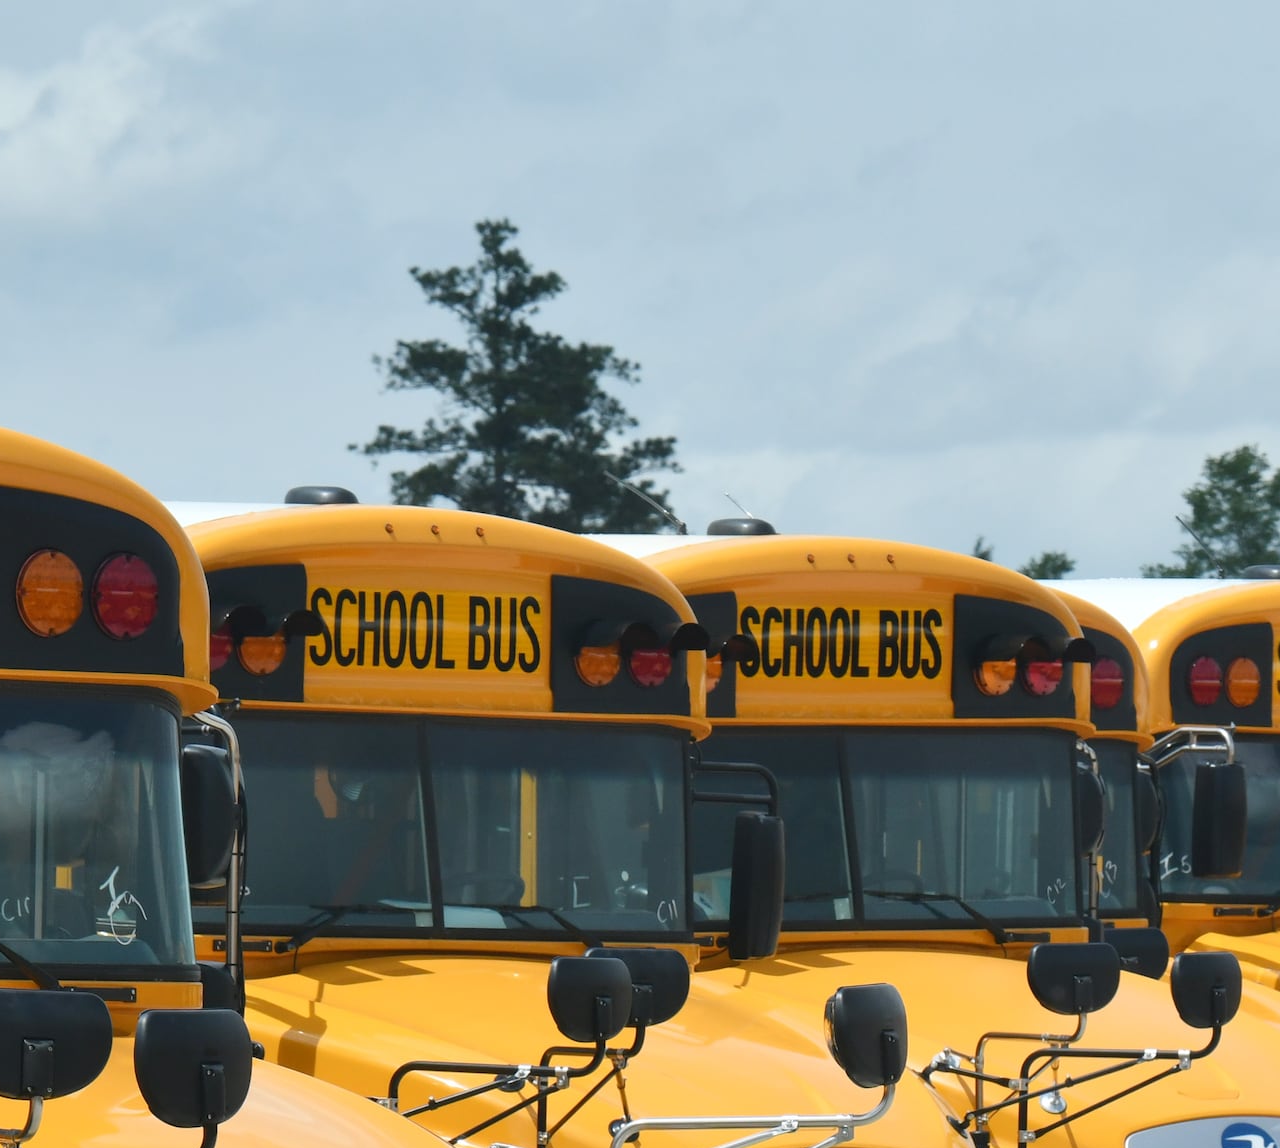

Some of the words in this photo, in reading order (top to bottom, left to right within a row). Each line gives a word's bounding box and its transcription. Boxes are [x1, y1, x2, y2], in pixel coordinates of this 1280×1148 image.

[308, 588, 454, 671] SCHOOL
[467, 594, 541, 674] BUS
[740, 605, 870, 679] SCHOOL
[877, 607, 943, 679] BUS
